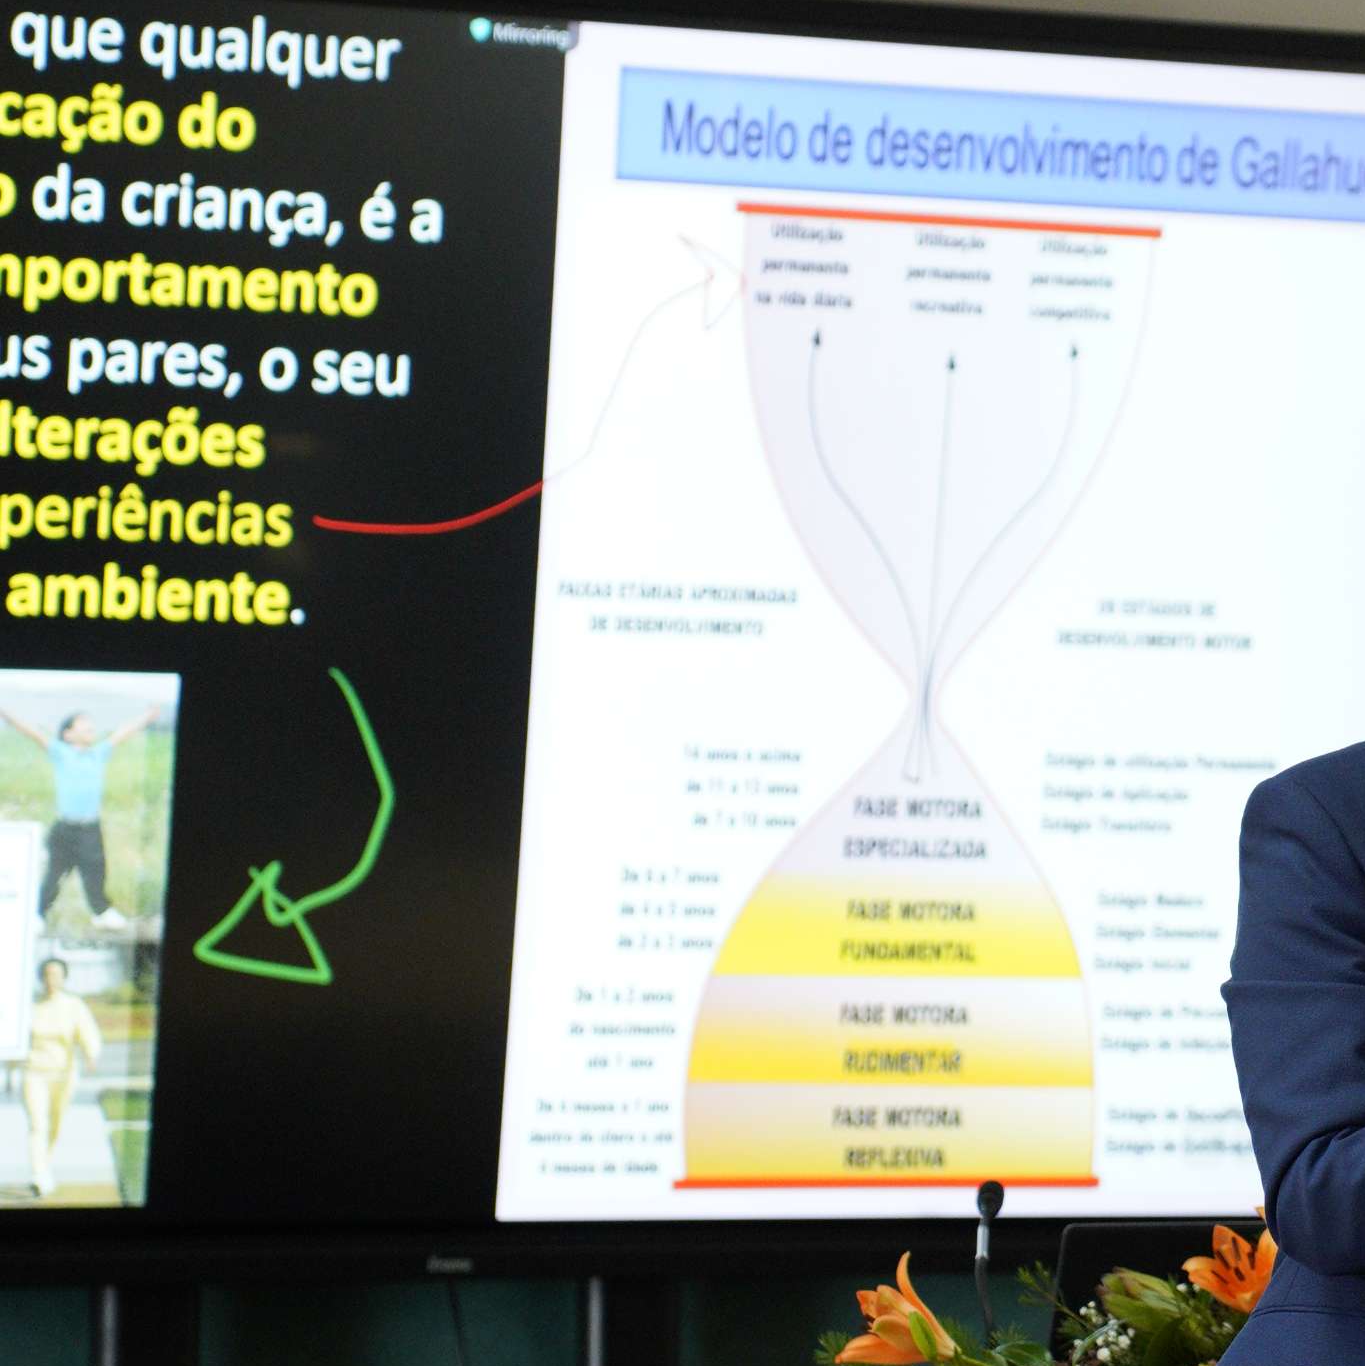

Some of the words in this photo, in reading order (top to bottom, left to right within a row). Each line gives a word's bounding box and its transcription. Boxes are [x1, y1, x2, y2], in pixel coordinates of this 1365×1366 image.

[10, 10, 126, 73] que
[139, 15, 402, 88] qualquer
[493, 21, 570, 53] Mirroring
[177, 90, 257, 151] do
[660, 97, 797, 161] Modelo
[808, 107, 855, 166] de
[865, 111, 1169, 186] desenvolvimento
[1175, 132, 1219, 187] de
[31, 162, 105, 223] da
[121, 171, 345, 246] criança,
[359, 181, 397, 241] é
[409, 196, 446, 244] a
[67, 336, 241, 398] pares,
[259, 345, 299, 392] o
[311, 349, 411, 398] seu
[5, 562, 306, 625] ambiente.
[854, 796, 898, 817] FASE
[906, 798, 981, 818] MOTORA
[844, 836, 986, 859] ESPECIALIZADA
[847, 899, 891, 921] FASE
[898, 901, 975, 921] MOTORA
[840, 939, 977, 962] FUNDAMENTAL
[840, 1004, 884, 1025] FASE
[893, 1005, 968, 1025] MOTORA
[834, 1107, 878, 1127] FASE
[886, 1108, 961, 1127] MOTORA
[845, 1148, 945, 1169] REFLEXIVA
